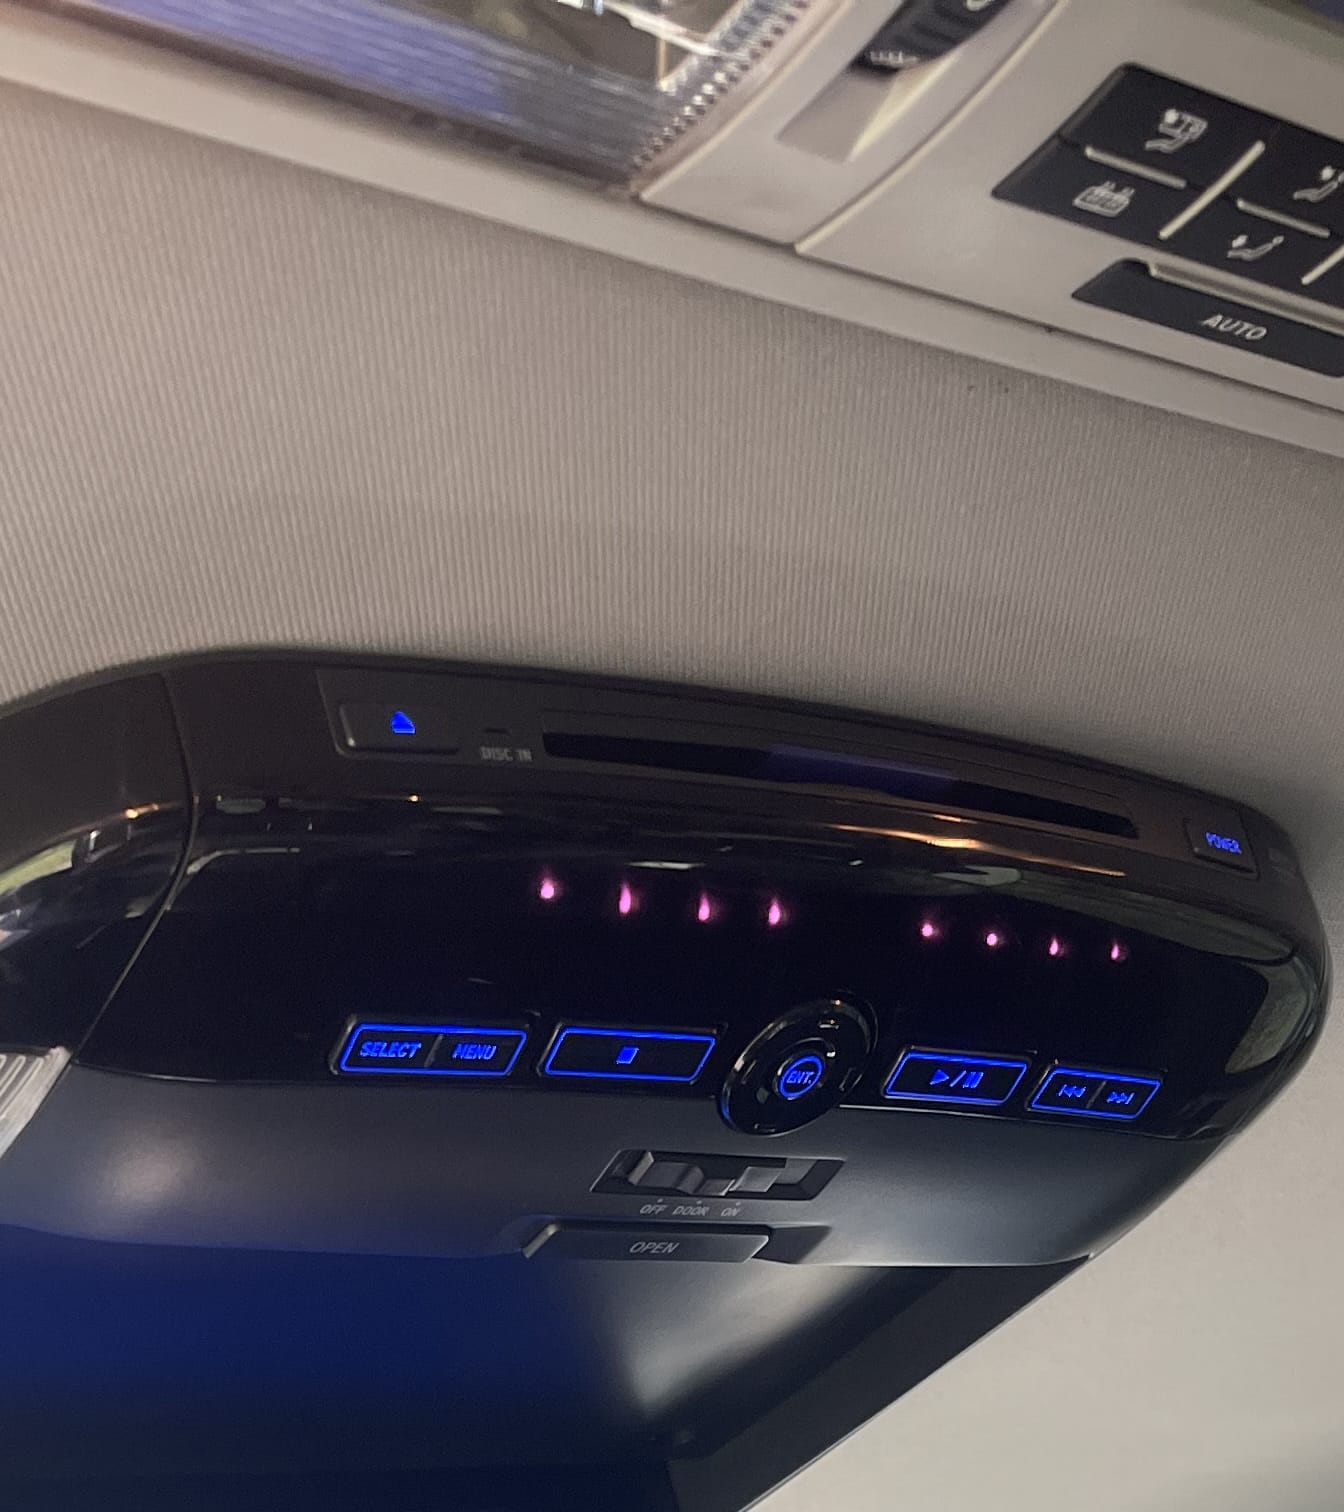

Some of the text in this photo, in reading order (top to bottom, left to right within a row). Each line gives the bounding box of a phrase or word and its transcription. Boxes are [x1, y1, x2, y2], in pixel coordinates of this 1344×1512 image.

[1201, 313, 1268, 340] AUTO
[480, 745, 533, 762] DISC IN
[1205, 831, 1243, 855] POWER
[359, 1041, 422, 1058] SELECT
[452, 1043, 497, 1060] MENU
[639, 1204, 742, 1217] OFF DOOR ON
[629, 1241, 680, 1254] OPEN
